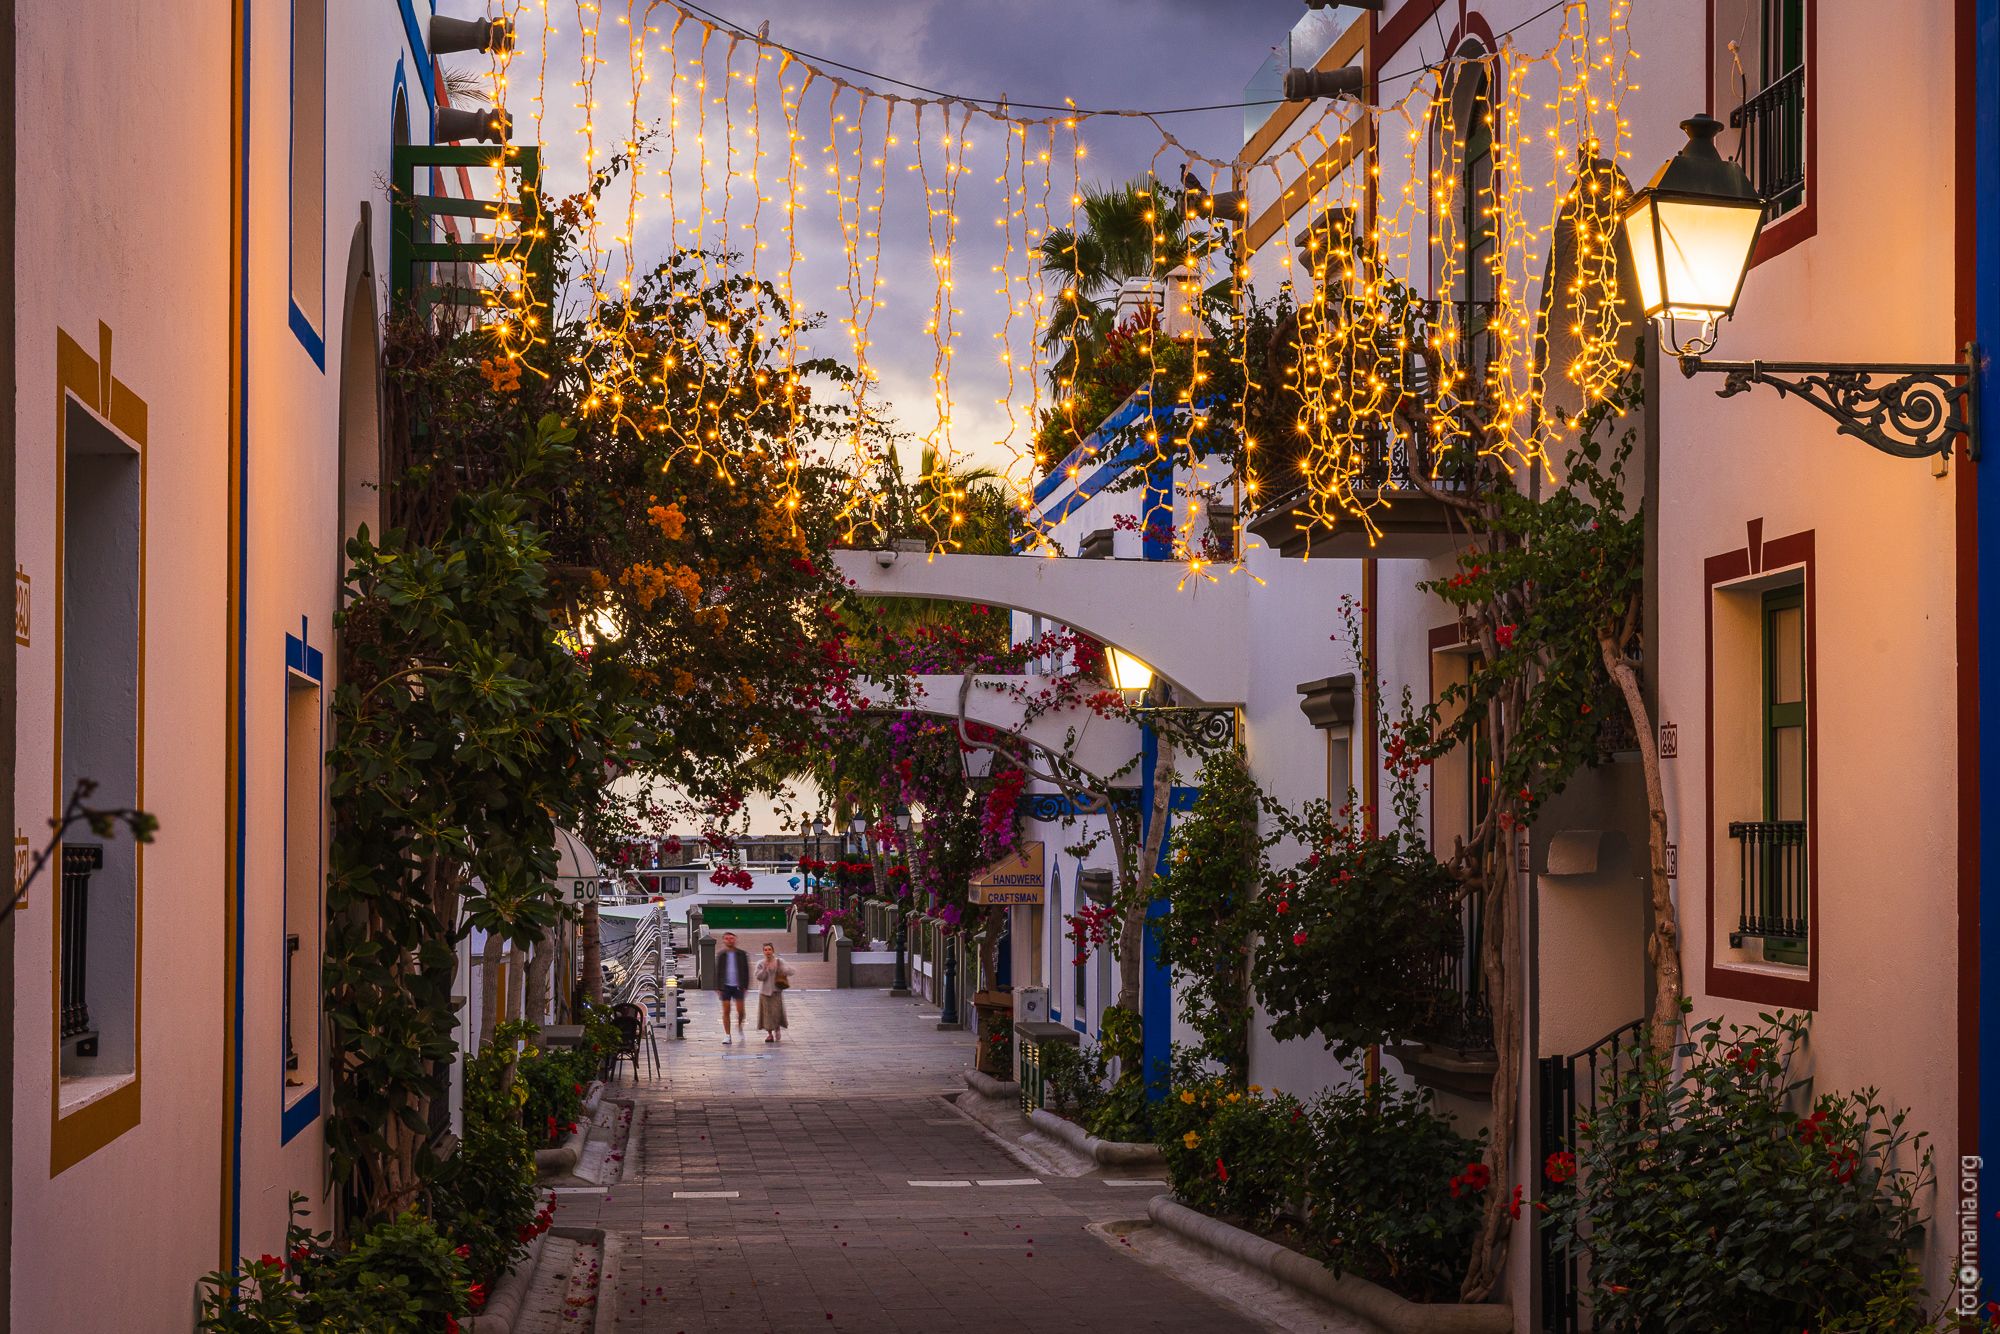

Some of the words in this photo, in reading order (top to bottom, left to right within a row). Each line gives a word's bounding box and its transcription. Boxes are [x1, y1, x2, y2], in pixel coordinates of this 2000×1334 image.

[1667, 850, 1675, 874] 19
[993, 874, 1042, 884] HANDWERK
[988, 893, 1038, 903] CRAFTSMAN
